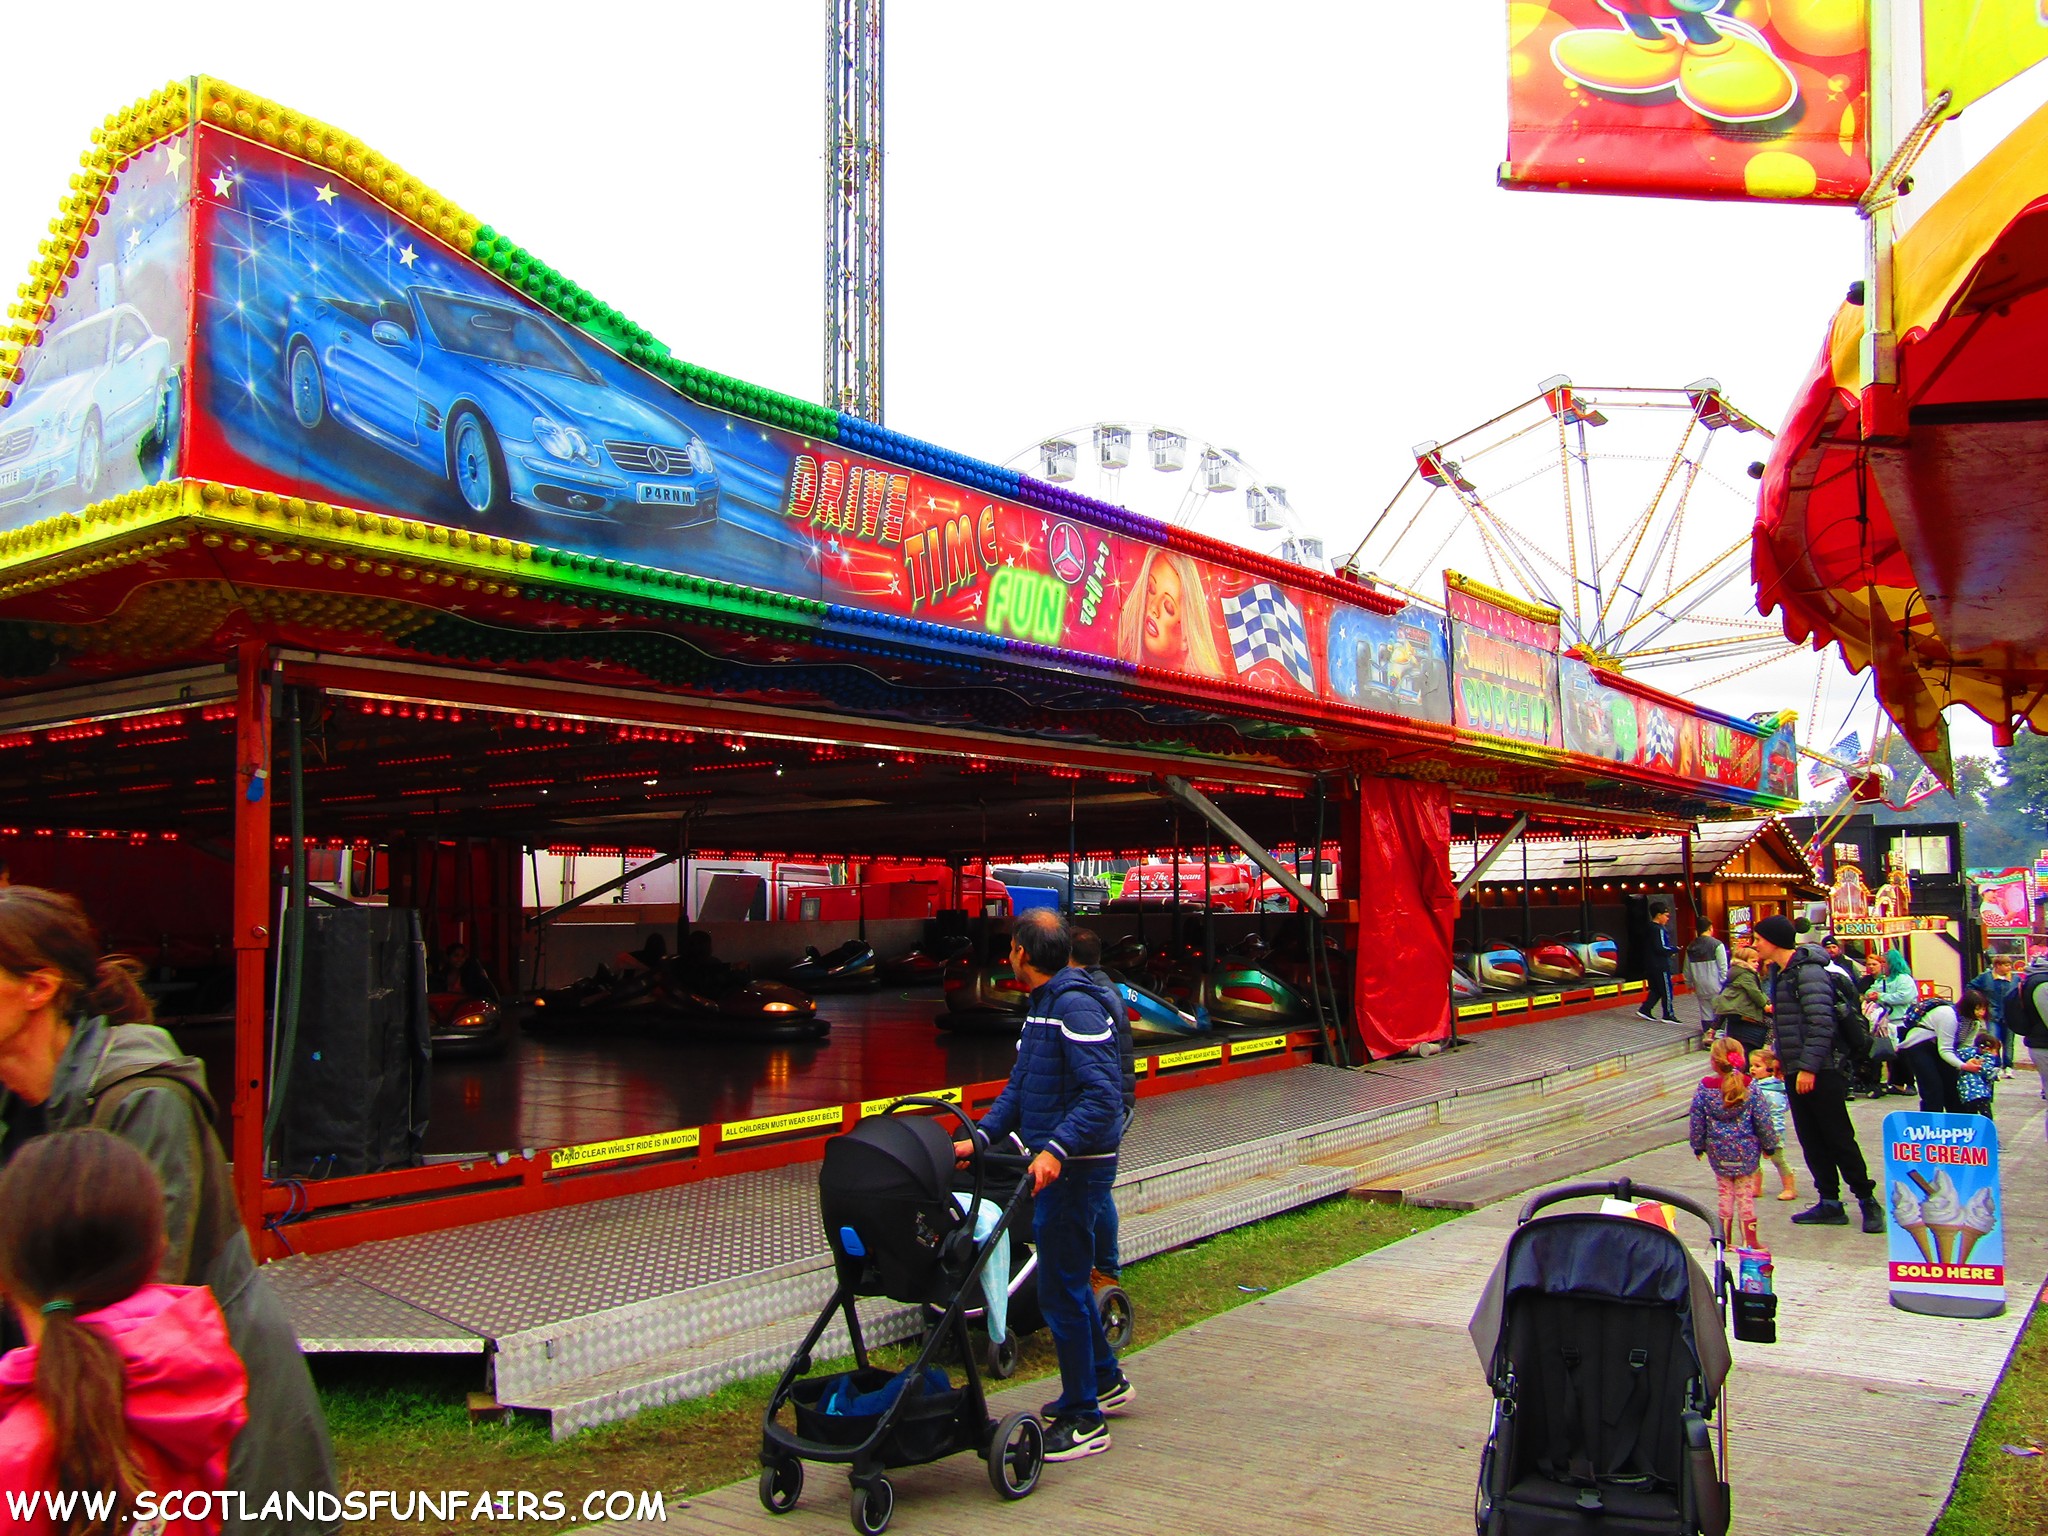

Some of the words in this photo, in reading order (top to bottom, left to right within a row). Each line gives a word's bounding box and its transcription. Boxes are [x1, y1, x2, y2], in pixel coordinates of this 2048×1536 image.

[645, 487, 691, 502] P4RNM
[786, 455, 910, 542] DRIVE
[904, 505, 999, 605] TIME
[985, 566, 1067, 644] FUN
[1152, 871, 1169, 881] The
[1846, 923, 1876, 934] EXIT
[1260, 974, 1267, 986] 2
[1126, 988, 1138, 1002] 16
[865, 1104, 877, 1113] ONE
[878, 1103, 889, 1111] WAY
[725, 1126, 738, 1136] ALL
[739, 1122, 770, 1134] CHILDREN
[771, 1119, 787, 1129] MUST
[788, 1116, 806, 1126] WEAR
[806, 1113, 821, 1123] SEAT
[822, 1111, 840, 1121] BELTS
[1903, 1125, 1975, 1145] Whippy
[553, 1150, 580, 1163] STAND
[581, 1147, 607, 1159] CLEAR
[608, 1143, 636, 1155] WHILST
[636, 1140, 653, 1150] RIDE
[654, 1138, 662, 1147] IS
[662, 1138, 670, 1146] IN
[670, 1134, 698, 1145] MOTION
[1892, 1142, 1922, 1163] ICE
[1925, 1144, 1989, 1167] CREAM
[1897, 1265, 1944, 1279] SOLD
[1947, 1267, 1996, 1280] HERE
